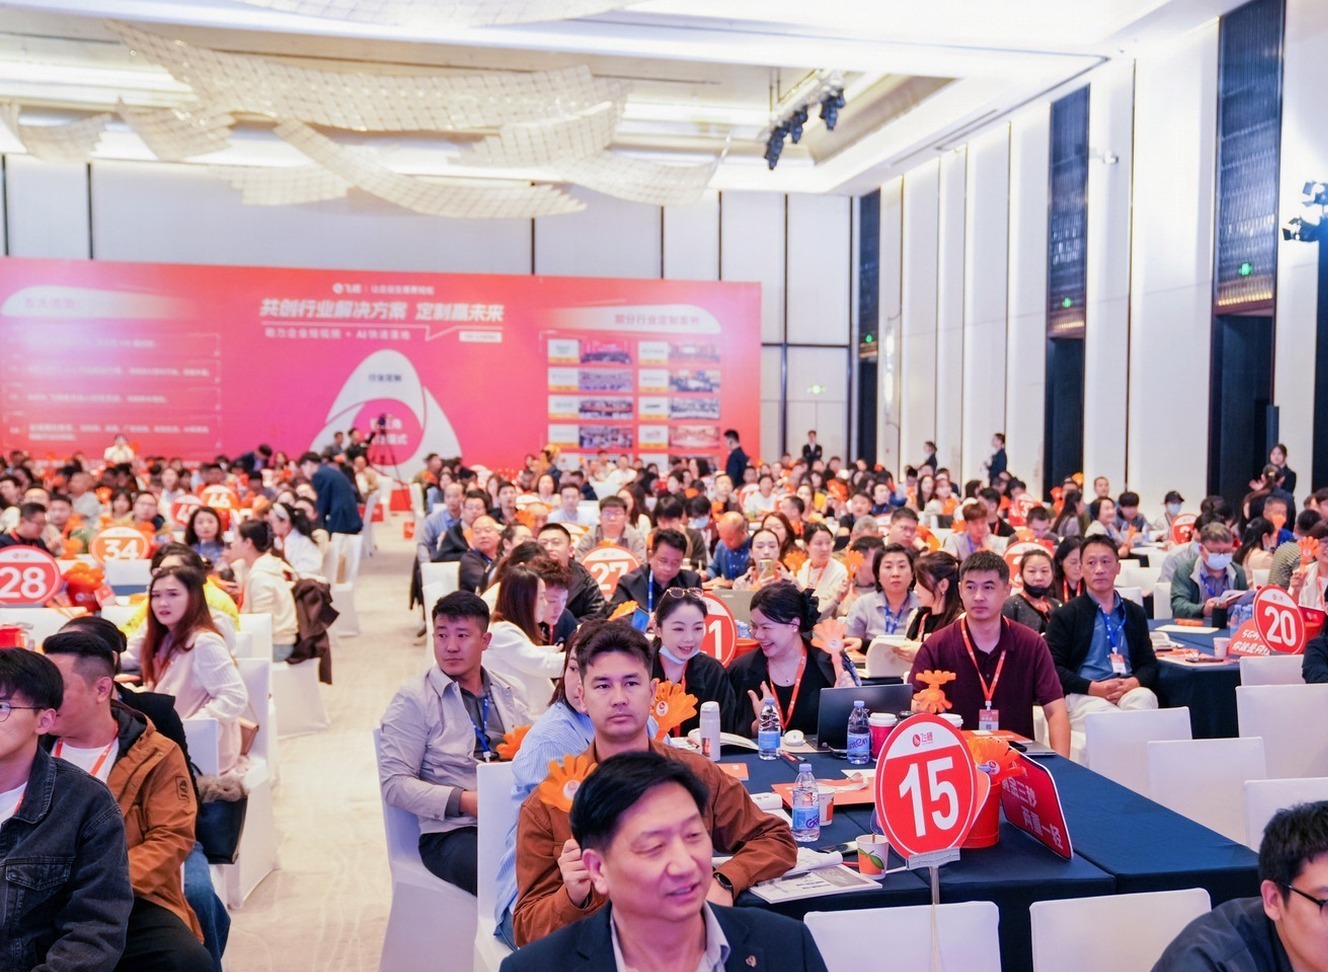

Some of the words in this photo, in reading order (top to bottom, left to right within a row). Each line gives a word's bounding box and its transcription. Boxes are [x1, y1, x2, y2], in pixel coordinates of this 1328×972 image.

[102, 539, 139, 561] 34
[0, 566, 47, 599] 28
[591, 561, 629, 590] 27
[1264, 605, 1297, 647] 20
[899, 756, 959, 838] 15
